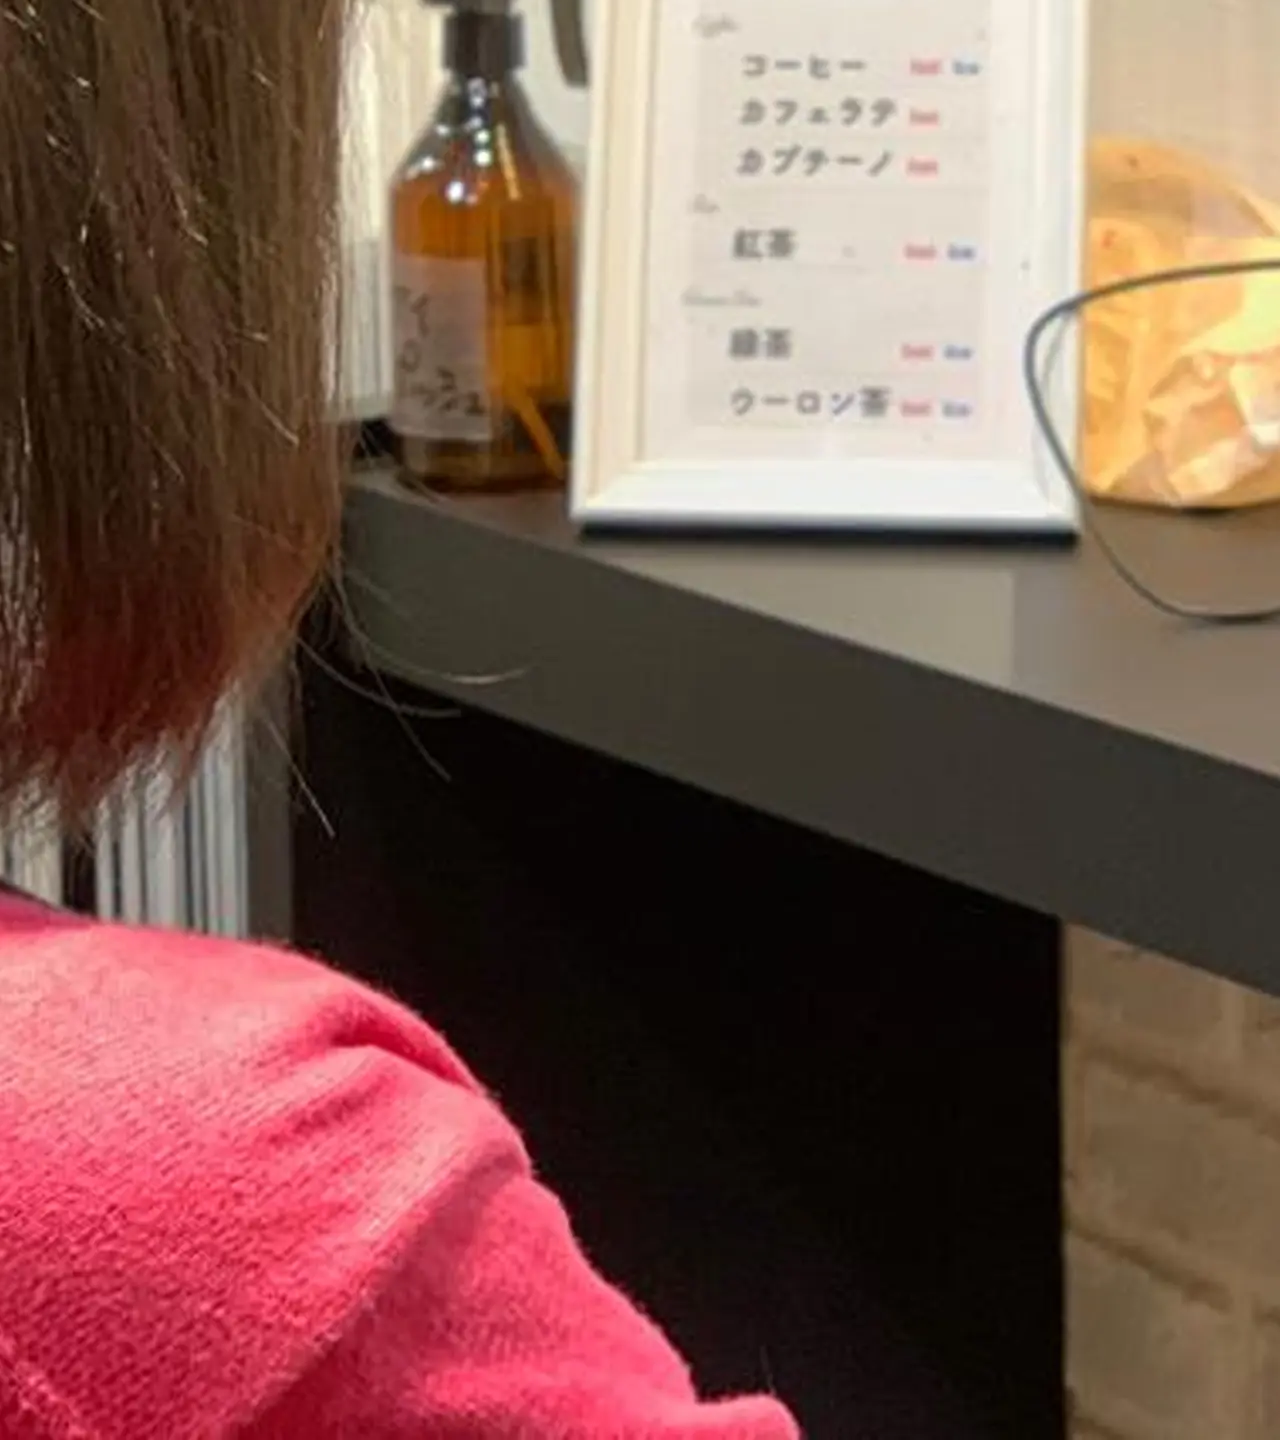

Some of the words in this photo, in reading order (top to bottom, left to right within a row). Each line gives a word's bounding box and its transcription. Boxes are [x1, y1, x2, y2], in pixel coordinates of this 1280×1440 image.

[742, 54, 867, 80] コーヒー
[739, 97, 897, 126] カフェラテ
[736, 143, 894, 177] カプチーノ
[732, 228, 797, 260] 紅茶
[730, 386, 891, 417] ウーロン茶
